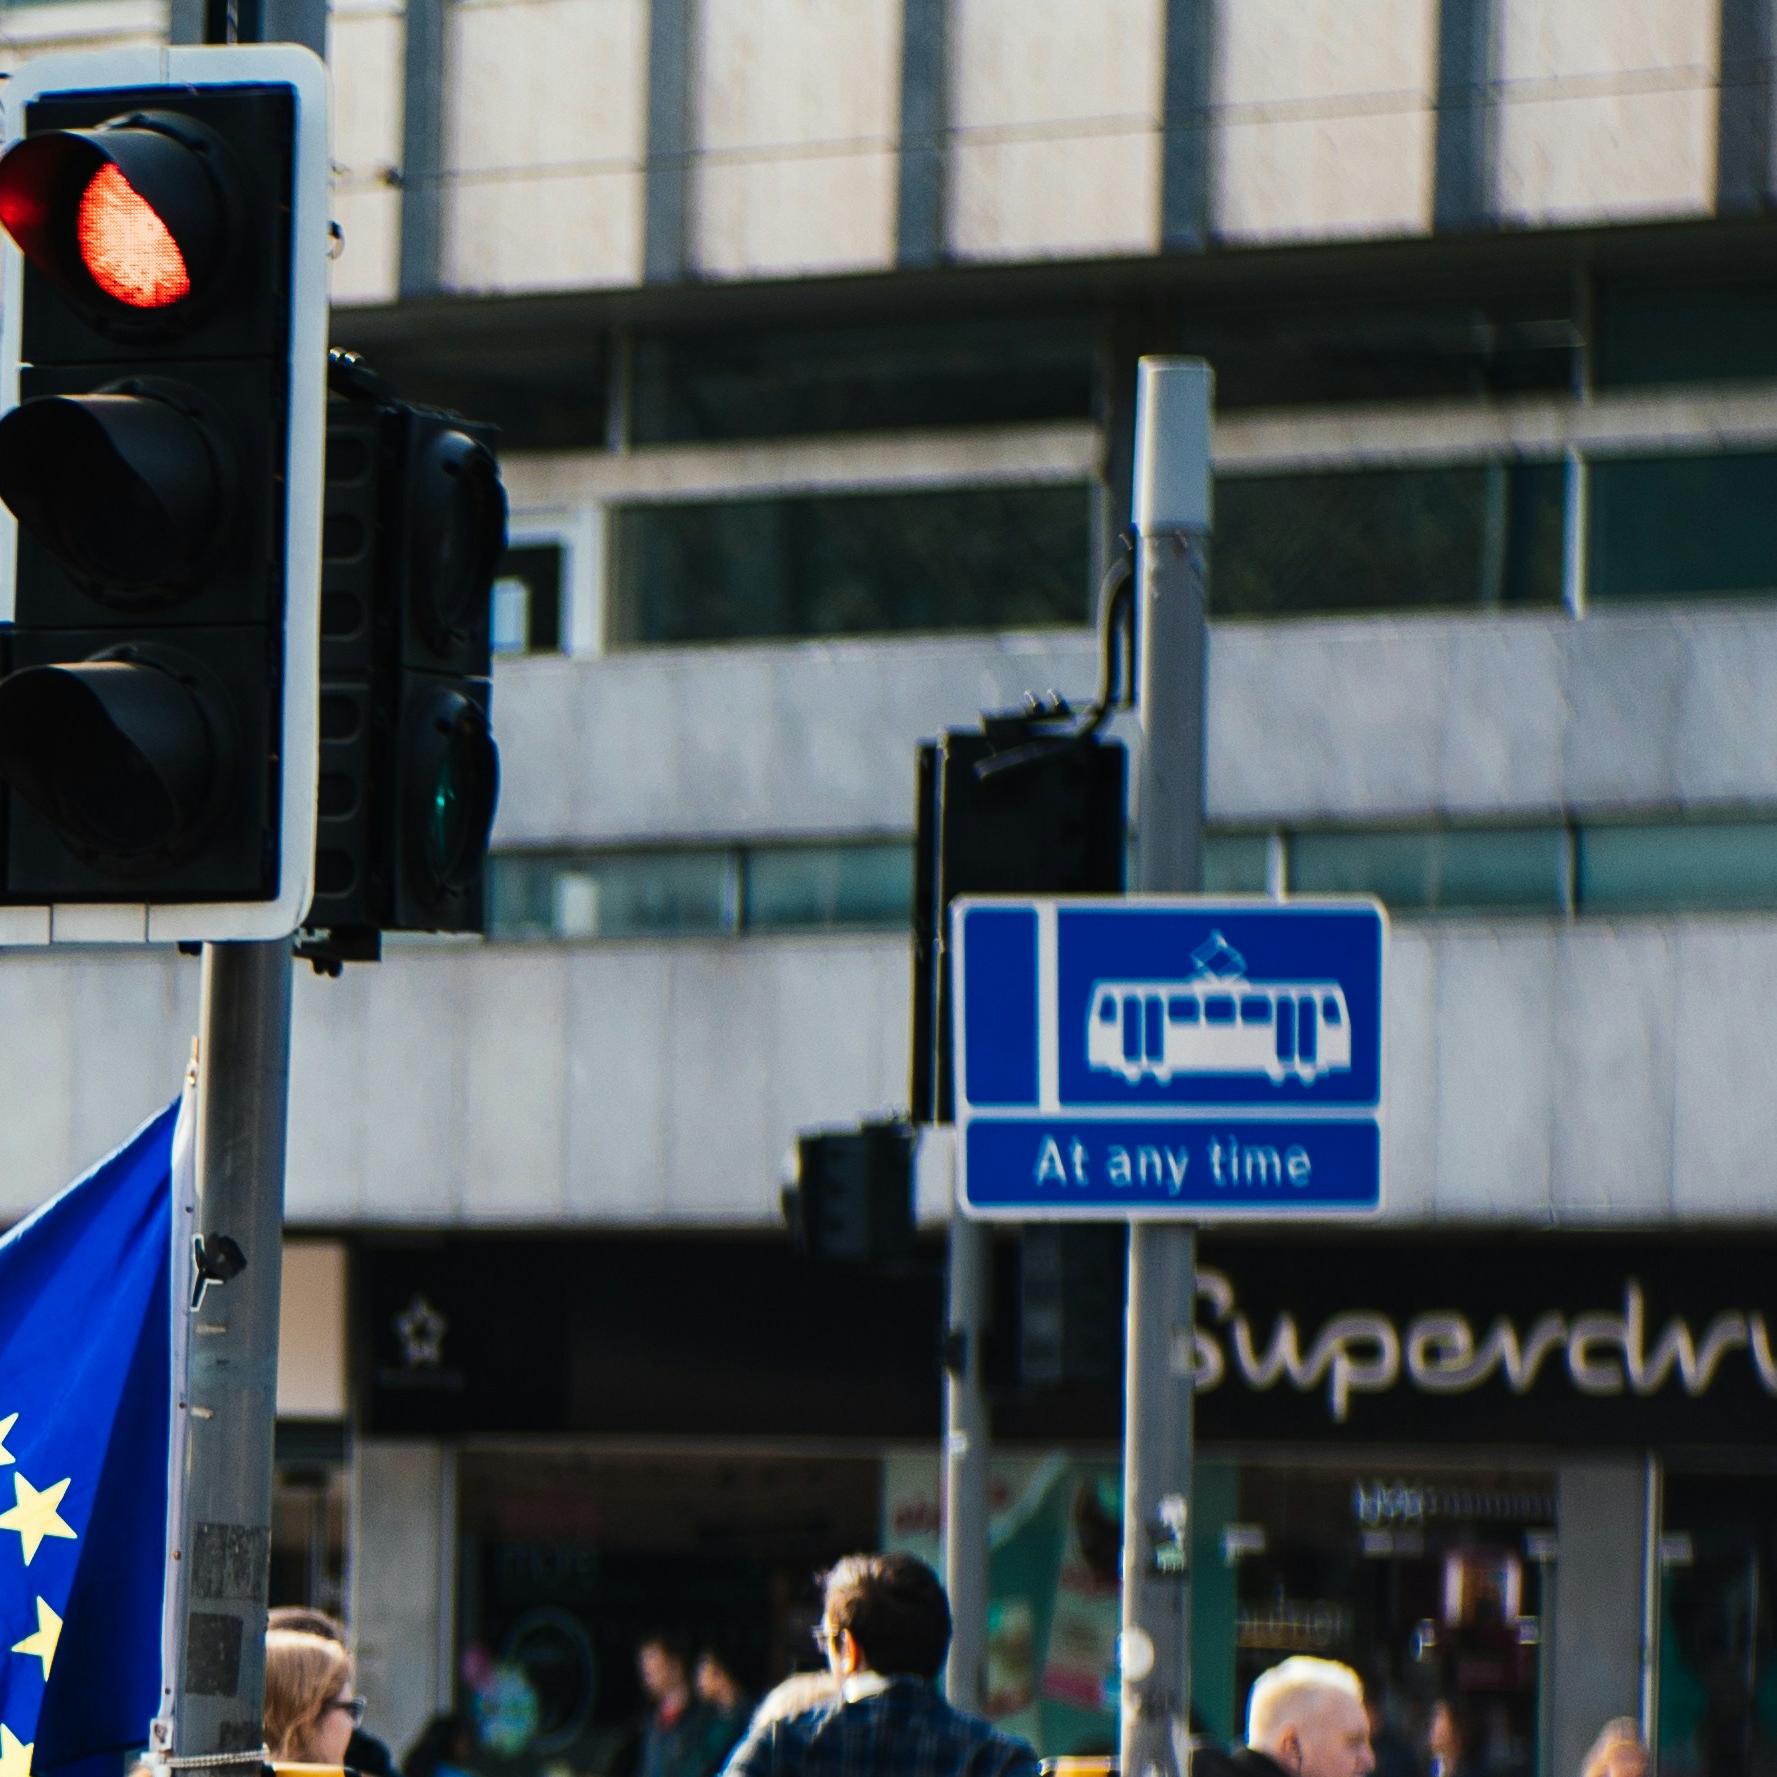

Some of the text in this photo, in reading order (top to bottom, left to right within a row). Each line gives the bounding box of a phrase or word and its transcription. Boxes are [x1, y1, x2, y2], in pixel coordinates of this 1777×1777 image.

[1033, 1133, 1312, 1196] At any time
